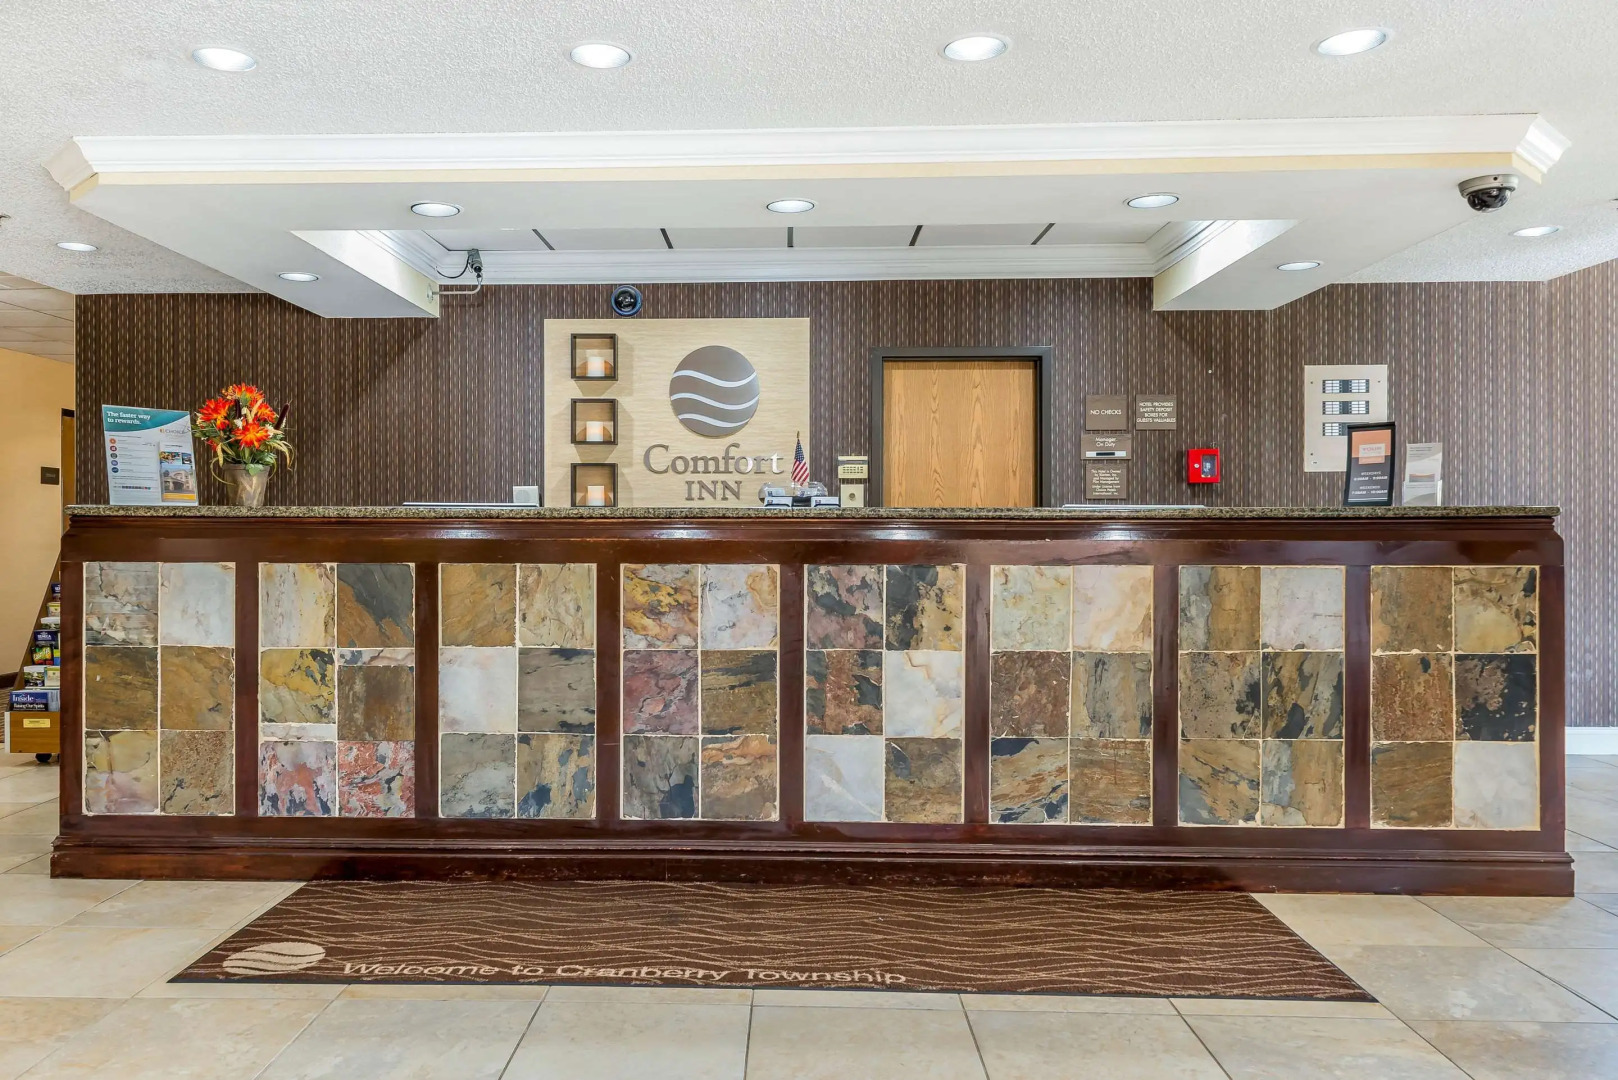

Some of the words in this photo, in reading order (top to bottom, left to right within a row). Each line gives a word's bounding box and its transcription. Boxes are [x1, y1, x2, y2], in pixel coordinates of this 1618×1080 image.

[643, 443, 784, 475] Comfort
[685, 480, 742, 501] INN
[343, 962, 501, 975] Welcome
[511, 964, 545, 976] to
[556, 964, 731, 981] Cranberry
[746, 968, 906, 984] Township
